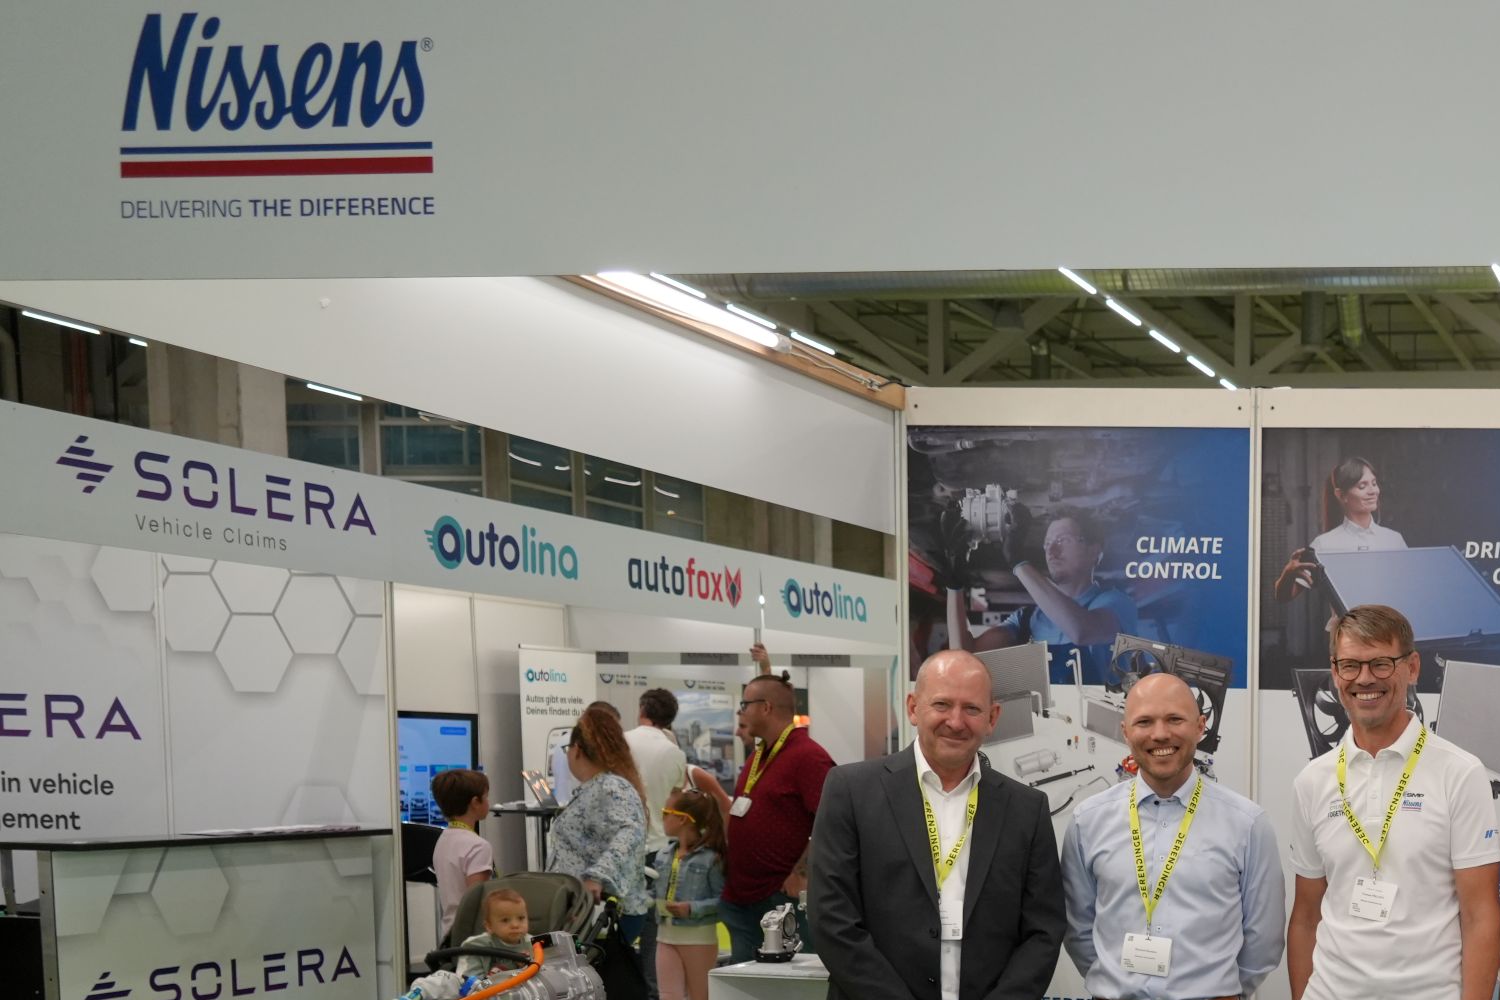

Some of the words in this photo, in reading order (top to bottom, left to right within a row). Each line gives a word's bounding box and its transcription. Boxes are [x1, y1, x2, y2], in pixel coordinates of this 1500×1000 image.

[121, 200, 242, 219] DELIVERING
[249, 198, 291, 217] THE
[300, 197, 435, 217] DIFFERENCE
[133, 450, 377, 536] SOLERA
[135, 514, 213, 541] Vehicle
[223, 527, 288, 551] Claims
[432, 516, 578, 581] autolina
[1136, 536, 1223, 554] CLIMATE
[627, 557, 724, 602] autofox
[1125, 561, 1222, 580] CONTROL
[784, 578, 867, 624] autolina
[526, 707, 547, 716] Deines
[30, 773, 115, 796] vehicle
[1132, 828, 1148, 898] DERENDINGER
[1154, 832, 1185, 901] DERENDINGER
